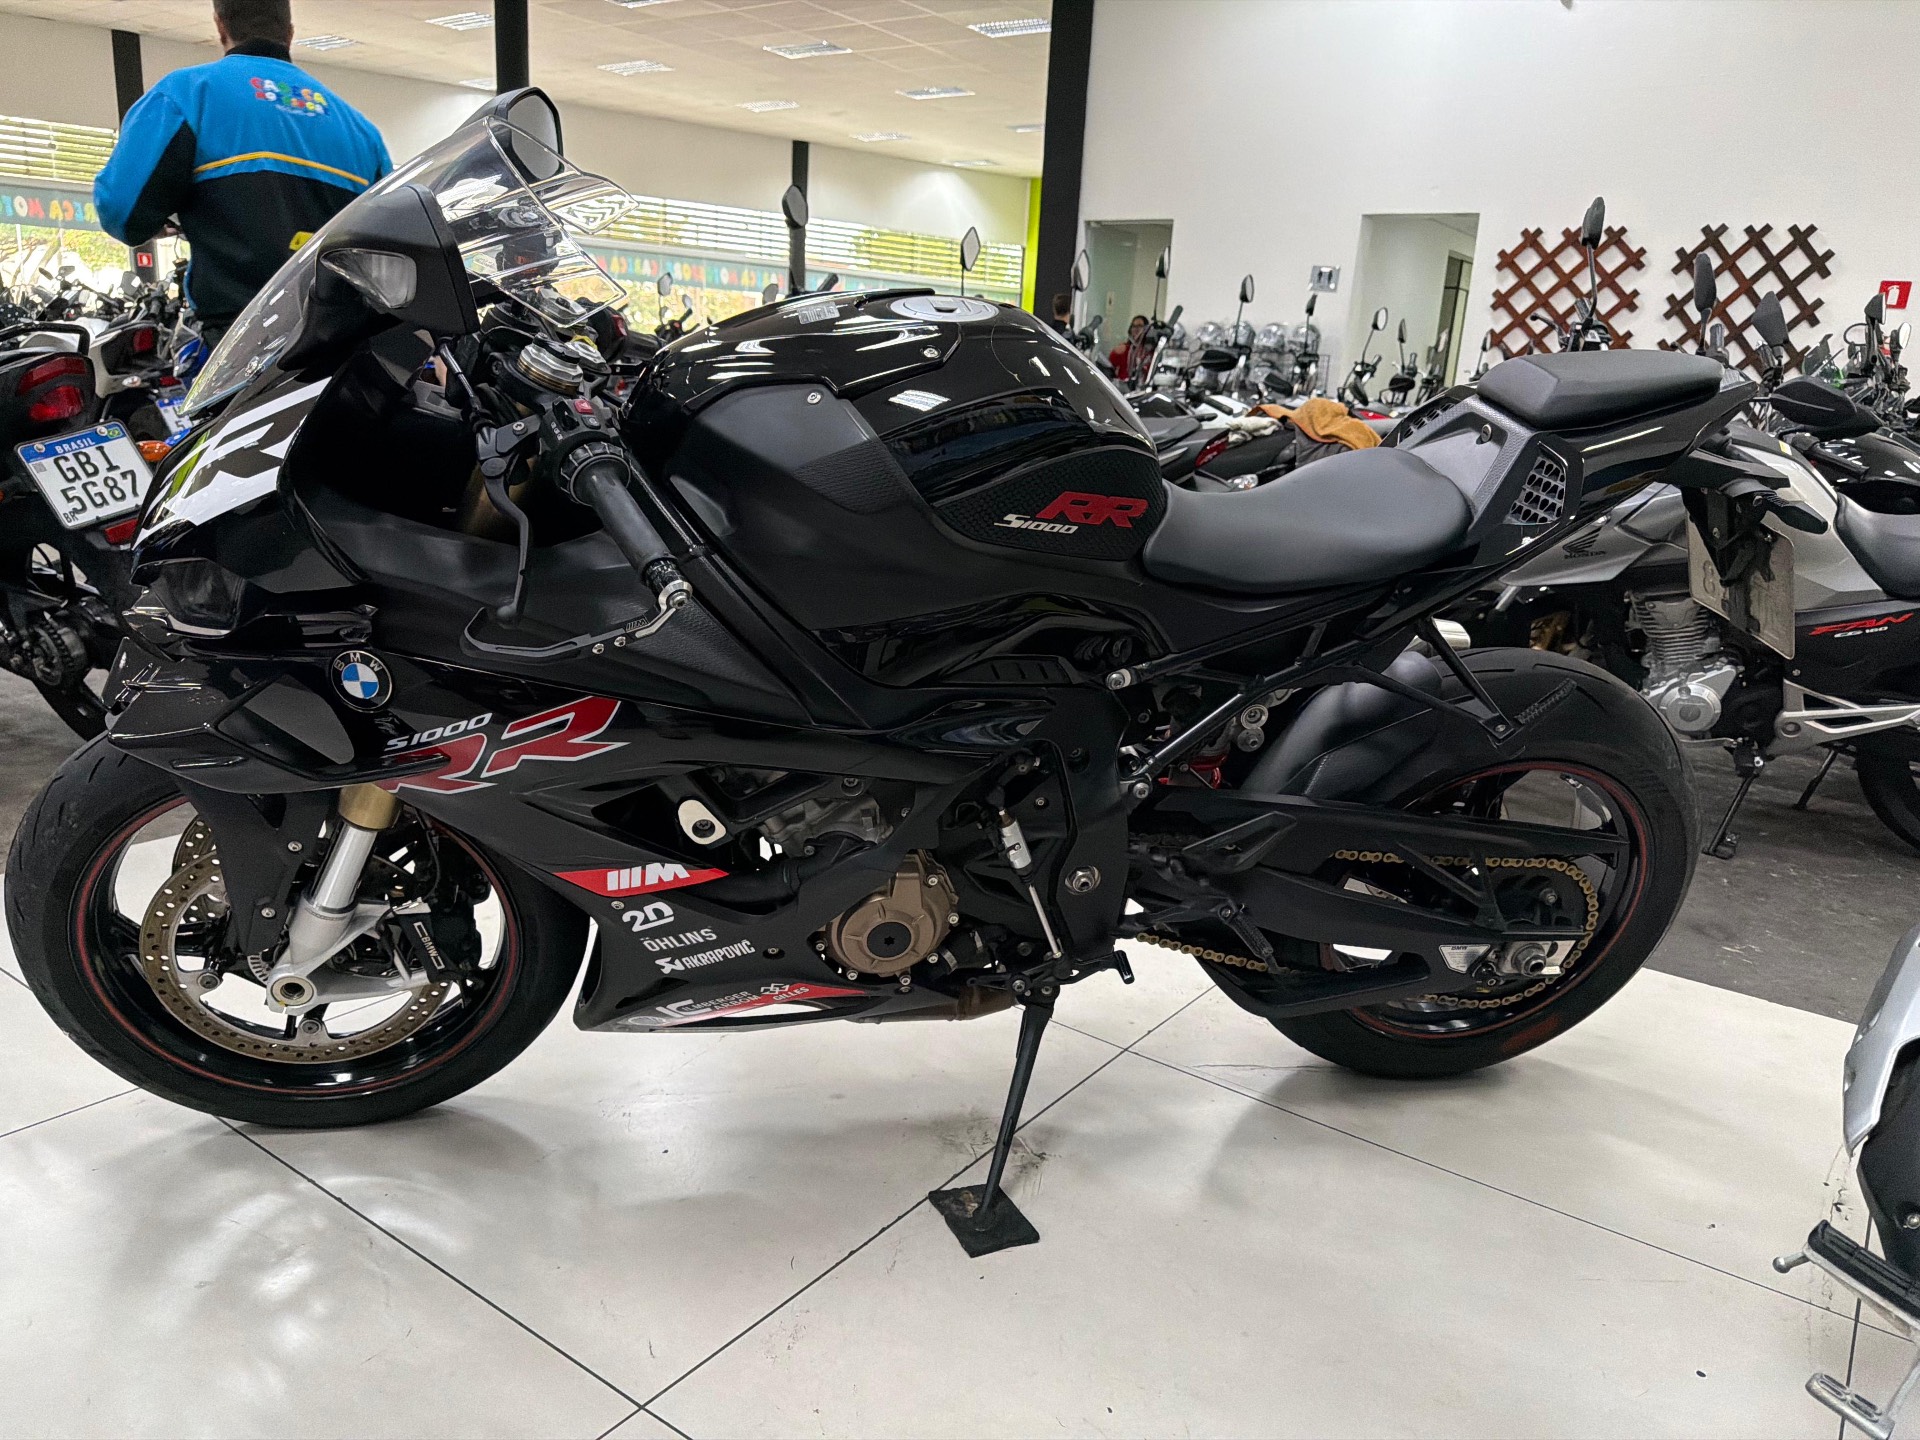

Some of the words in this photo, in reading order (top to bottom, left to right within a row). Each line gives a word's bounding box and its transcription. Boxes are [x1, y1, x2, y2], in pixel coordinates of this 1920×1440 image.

[54, 437, 96, 454] BRASIL
[53, 445, 121, 484] GBI
[60, 469, 140, 515] 5G87
[62, 510, 79, 524] BR
[1035, 490, 1149, 528] RR
[993, 513, 1079, 535] S1000
[333, 651, 382, 672] BMW
[384, 711, 493, 752] S1000
[421, 936, 439, 957] BMW
[640, 928, 718, 952] ÖHLINS
[772, 986, 810, 1001] GILLES
